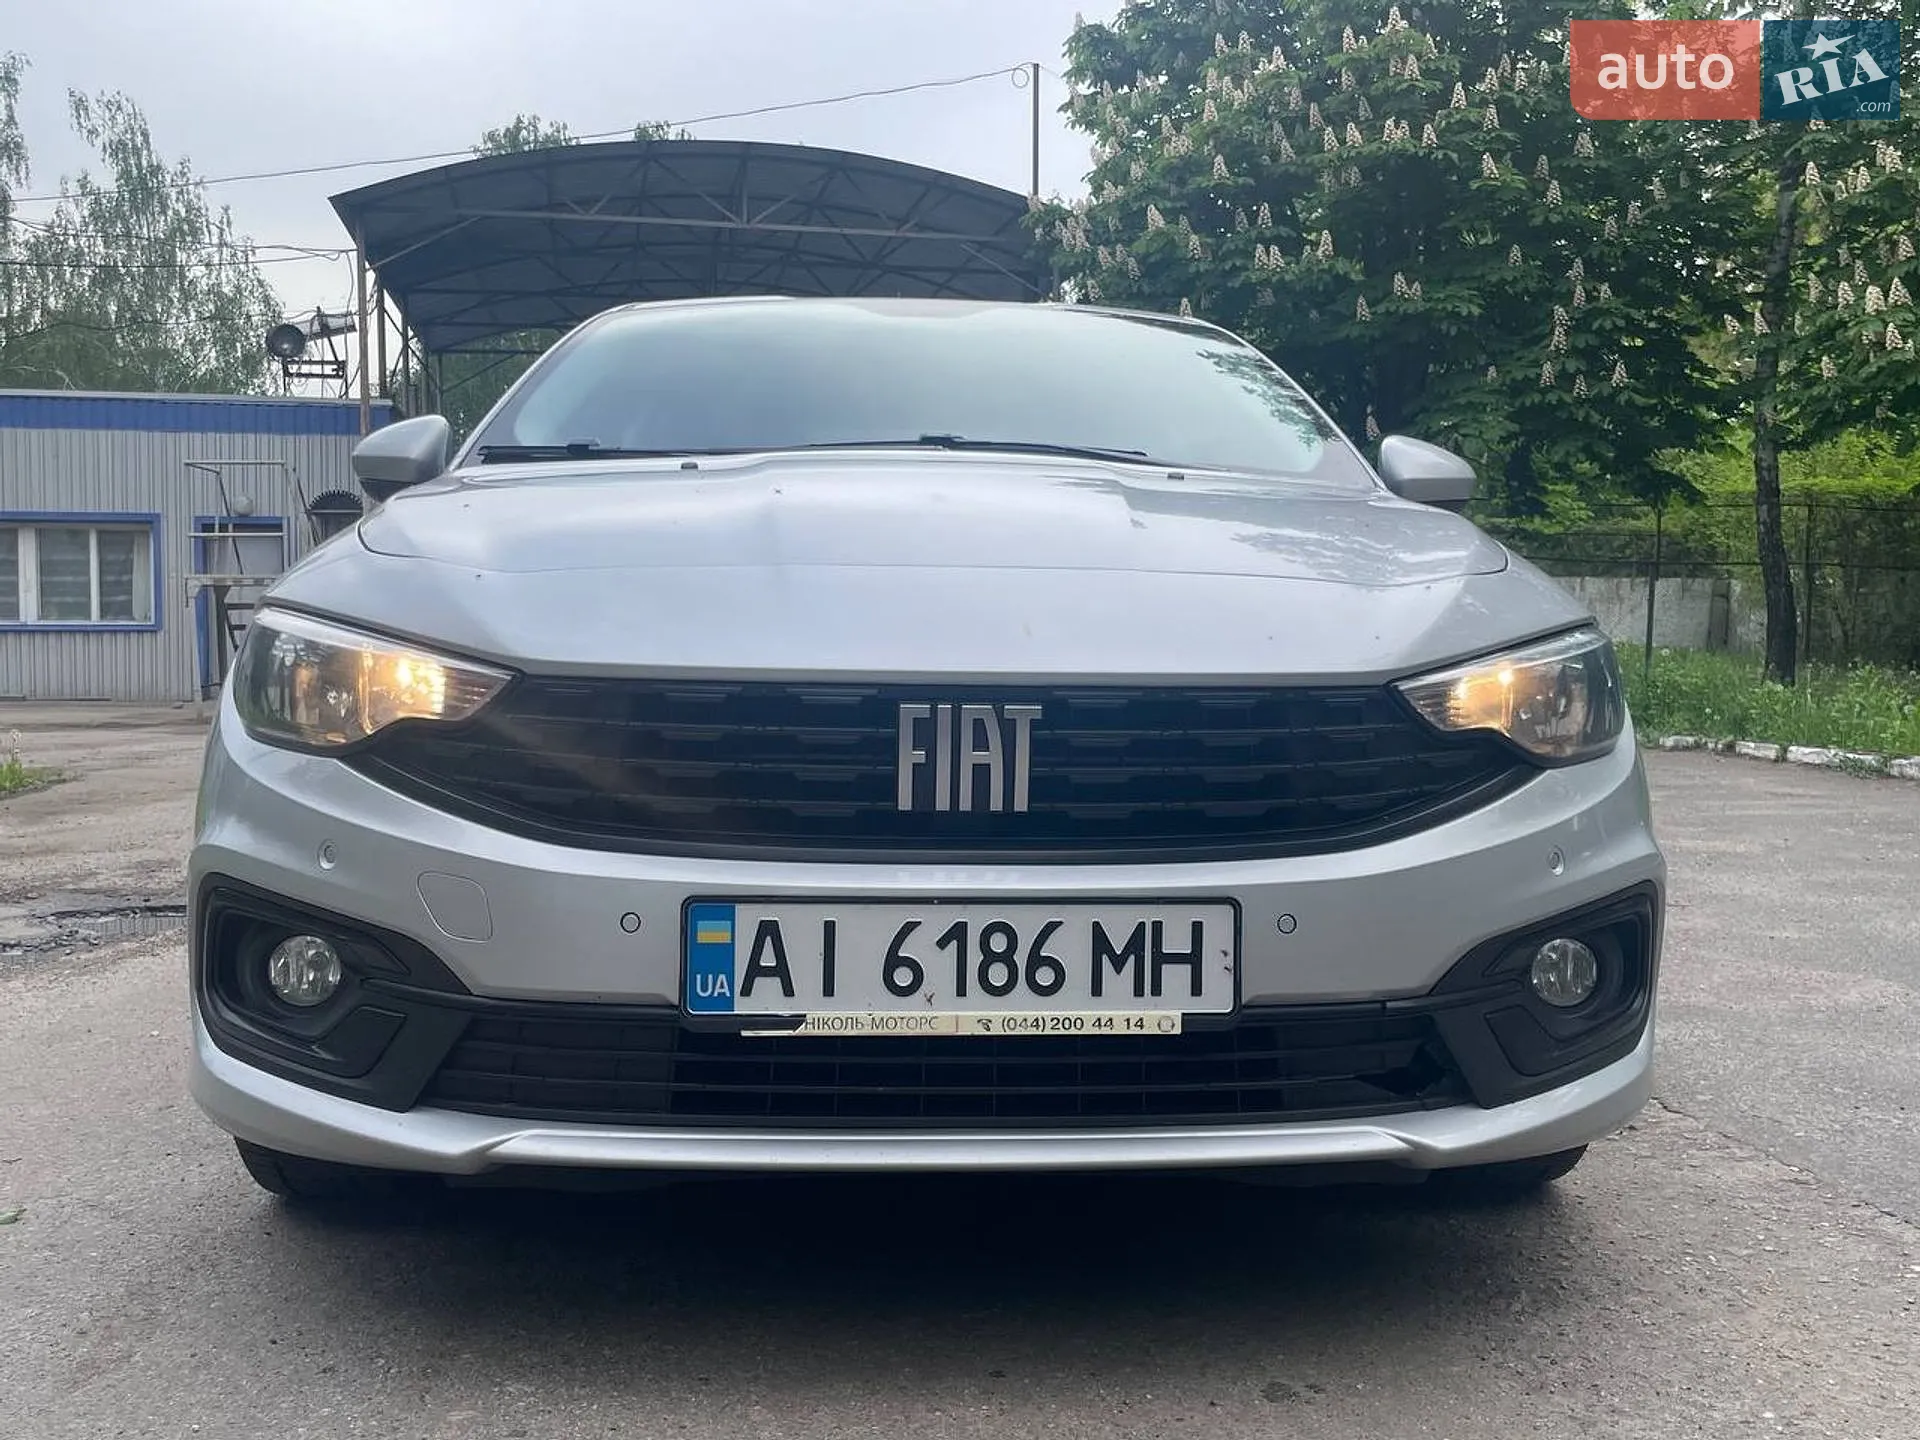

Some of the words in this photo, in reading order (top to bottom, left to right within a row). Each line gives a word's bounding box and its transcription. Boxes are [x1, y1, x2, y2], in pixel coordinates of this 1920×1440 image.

[898, 703, 1043, 812] FIAT
[739, 918, 837, 998] AI
[882, 919, 1067, 998] 6186
[1090, 919, 1204, 998] MH
[695, 973, 731, 998] UA
[1001, 1015, 1046, 1033] (044)
[1049, 1016, 1085, 1031] 200
[1091, 1017, 1115, 1031] 44
[1123, 1016, 1145, 1031] 14
